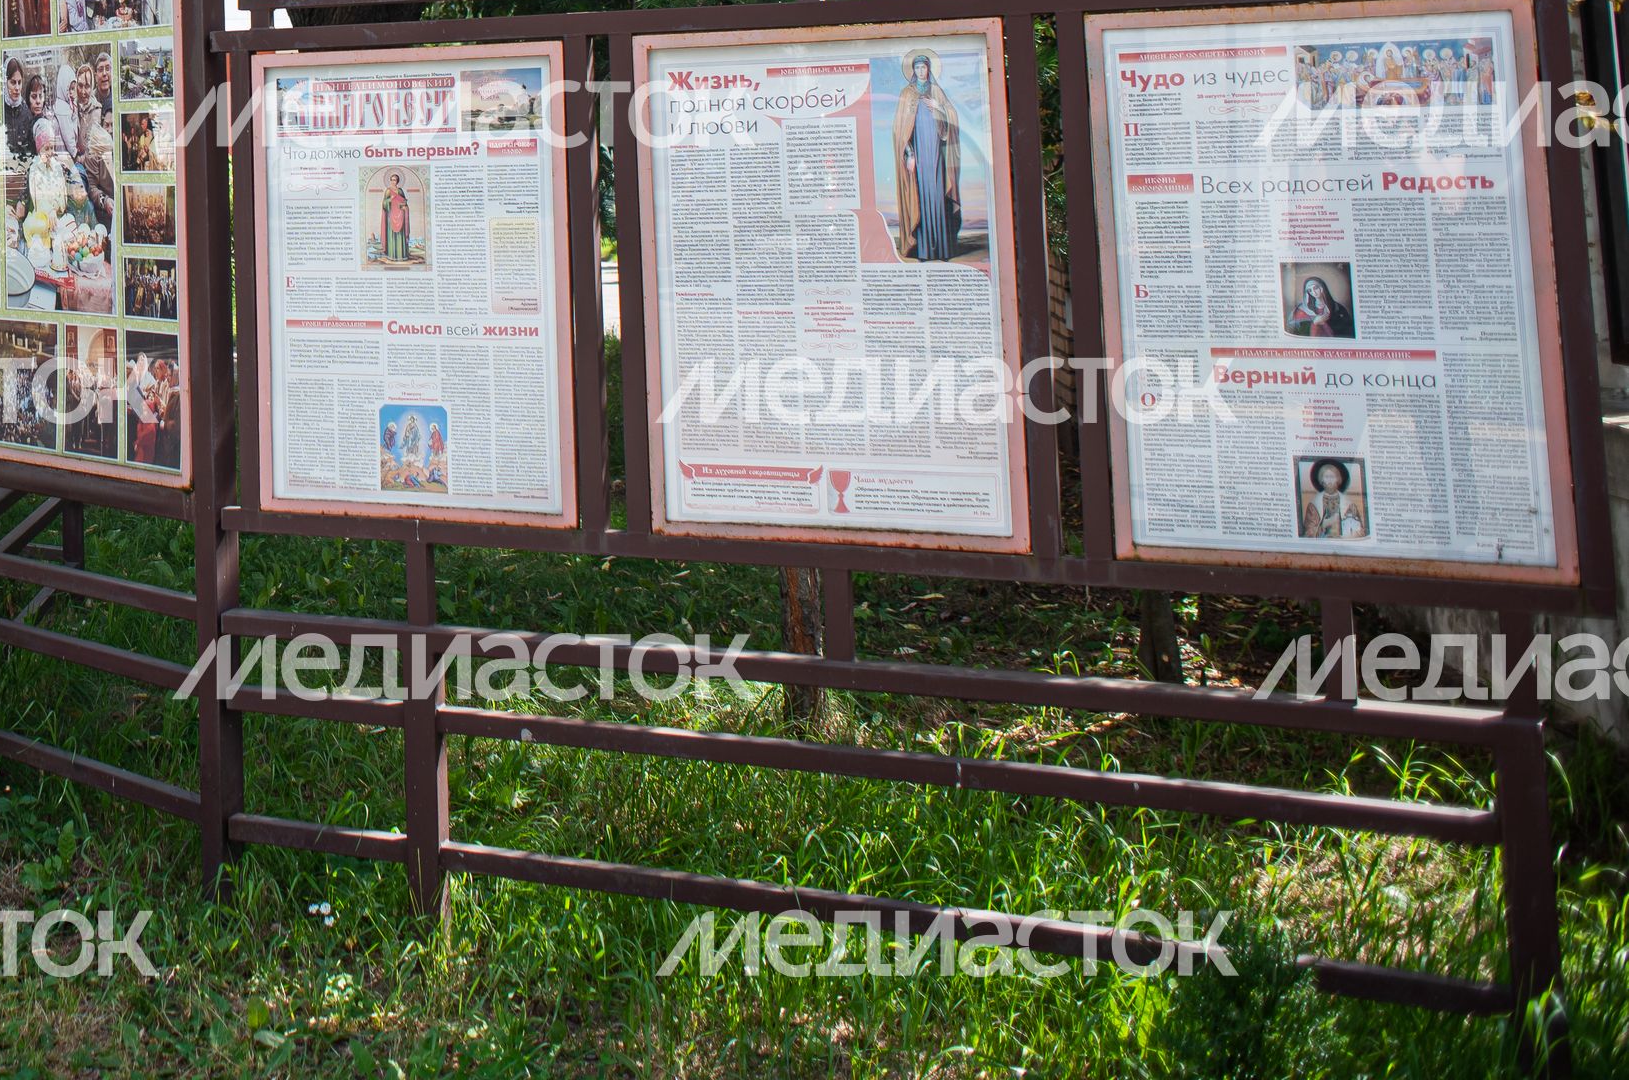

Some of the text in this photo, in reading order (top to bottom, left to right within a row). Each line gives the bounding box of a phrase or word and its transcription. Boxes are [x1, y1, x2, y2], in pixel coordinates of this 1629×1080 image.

[667, 71, 761, 92] Жизнь,
[1120, 69, 1289, 92] Чудо из чудес
[670, 87, 846, 114] полная скорбей
[670, 114, 758, 135] и любви
[283, 141, 480, 161] Что должно быть первым?
[1201, 171, 1495, 199] Всех радостей Радость
[387, 319, 539, 337] Смысл всей жизни
[1213, 365, 1436, 389] Верный до конца
